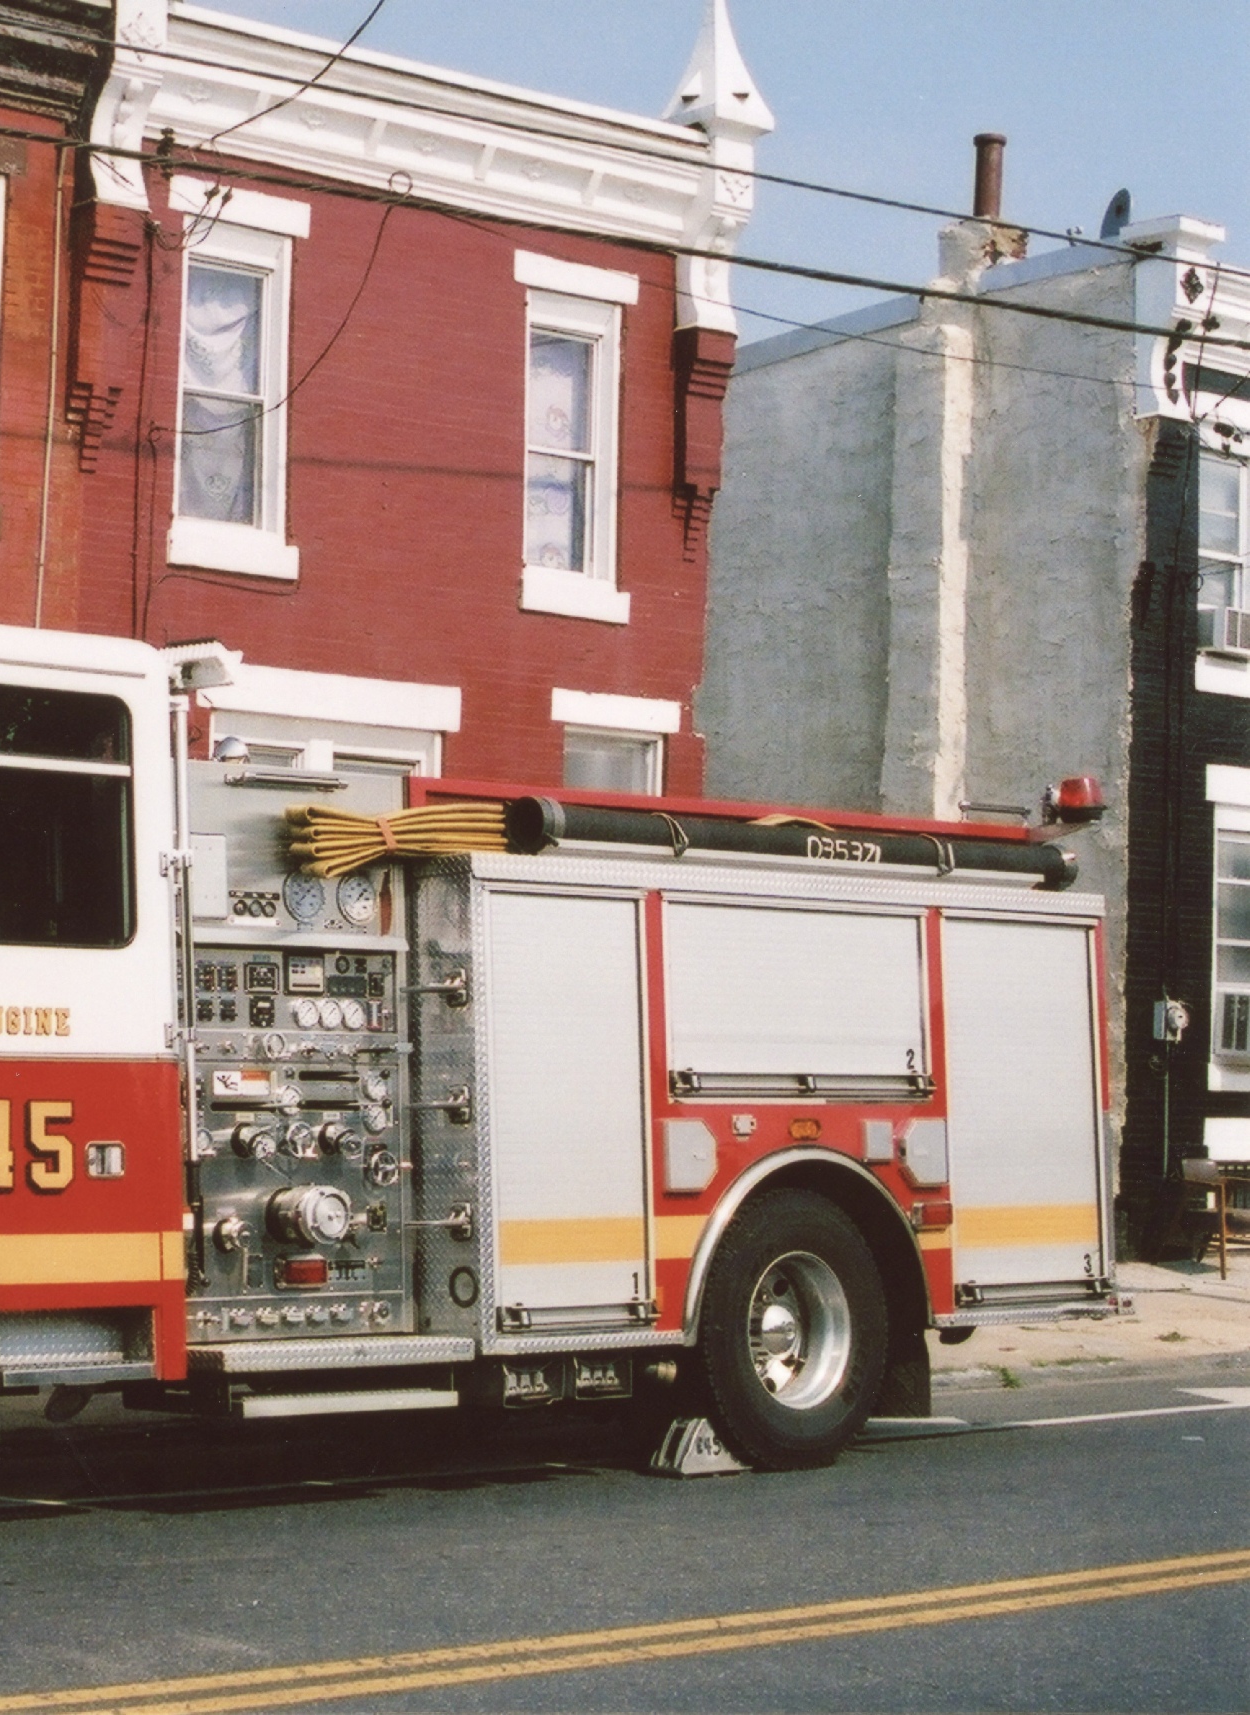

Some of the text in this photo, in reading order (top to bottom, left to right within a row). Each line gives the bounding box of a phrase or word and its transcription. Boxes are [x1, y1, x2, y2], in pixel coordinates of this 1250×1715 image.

[906, 1048, 915, 1070] 2
[1083, 1253, 1092, 1274] 3
[631, 1271, 639, 1295] 1
